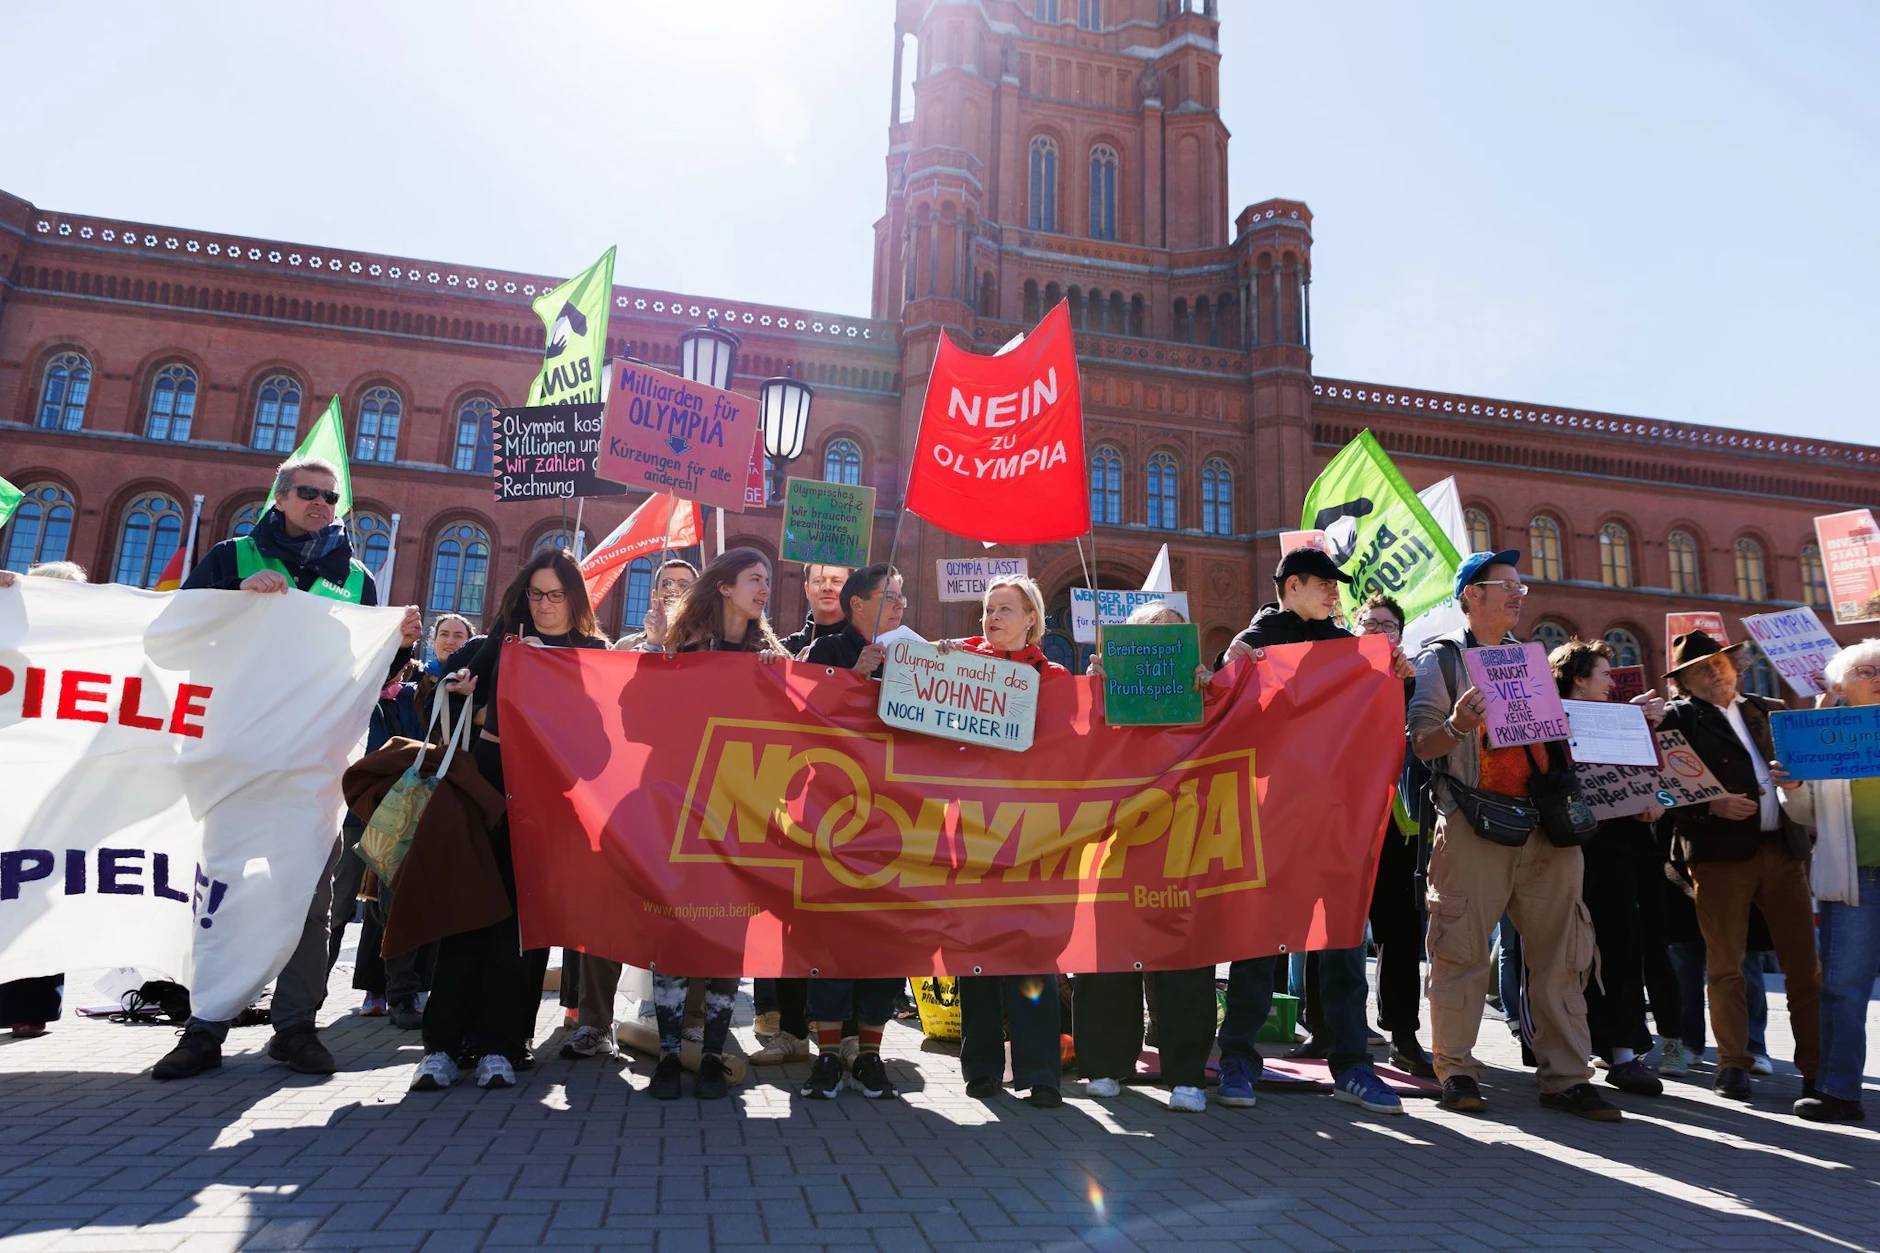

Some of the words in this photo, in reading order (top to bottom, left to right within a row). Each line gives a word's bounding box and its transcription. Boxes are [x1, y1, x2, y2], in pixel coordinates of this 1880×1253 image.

[620, 367, 703, 412] Milliarden
[714, 394, 740, 422] für
[948, 366, 1058, 429] NEIN
[503, 415, 565, 441] Olympia
[629, 397, 724, 448] OLYMPIA
[506, 436, 575, 456] Millionen
[990, 434, 1016, 450] ZU
[505, 455, 530, 473] wir
[535, 453, 586, 473] zahlen
[609, 436, 682, 472] Kürzungen
[687, 460, 706, 480] für
[710, 467, 731, 482] alle
[933, 440, 1067, 480] OLYMPIA
[503, 474, 574, 498] Rechnung
[644, 468, 698, 494] anderen!
[793, 483, 854, 499] Olympisches
[791, 505, 808, 517] Wir
[811, 507, 857, 524] brauchen
[790, 517, 848, 534] bezahlbares
[808, 530, 860, 548] WOHNEN!
[946, 560, 982, 576] OLYMPIA
[987, 560, 1019, 575] LÄSST
[321, 578, 352, 598] BUND
[1072, 588, 1122, 605] WENGER
[1107, 639, 1183, 658] Breitensport
[1480, 647, 1526, 667] BERLIN
[894, 643, 945, 676] Olympia
[956, 663, 996, 683] macht
[1004, 668, 1028, 691] das
[1135, 658, 1175, 676] statt
[1486, 664, 1529, 682] BRAUCHT
[914, 673, 1007, 717] WOHNEN
[1109, 680, 1184, 700] Prunkspiele
[1495, 681, 1532, 700] VIEL
[886, 701, 924, 722] NOCH
[1508, 700, 1531, 712] ABER
[1504, 710, 1536, 724] KEINE
[1782, 710, 1863, 730] Milliarden
[1495, 719, 1567, 745] PRUNKSPIELE
[1787, 749, 1860, 767] Kürzungen
[1581, 770, 1619, 790] eine
[1629, 781, 1654, 797] für
[1657, 774, 1682, 790] die
[1134, 885, 1190, 908] Berlin
[643, 901, 761, 921] www.nolympia.berlin
